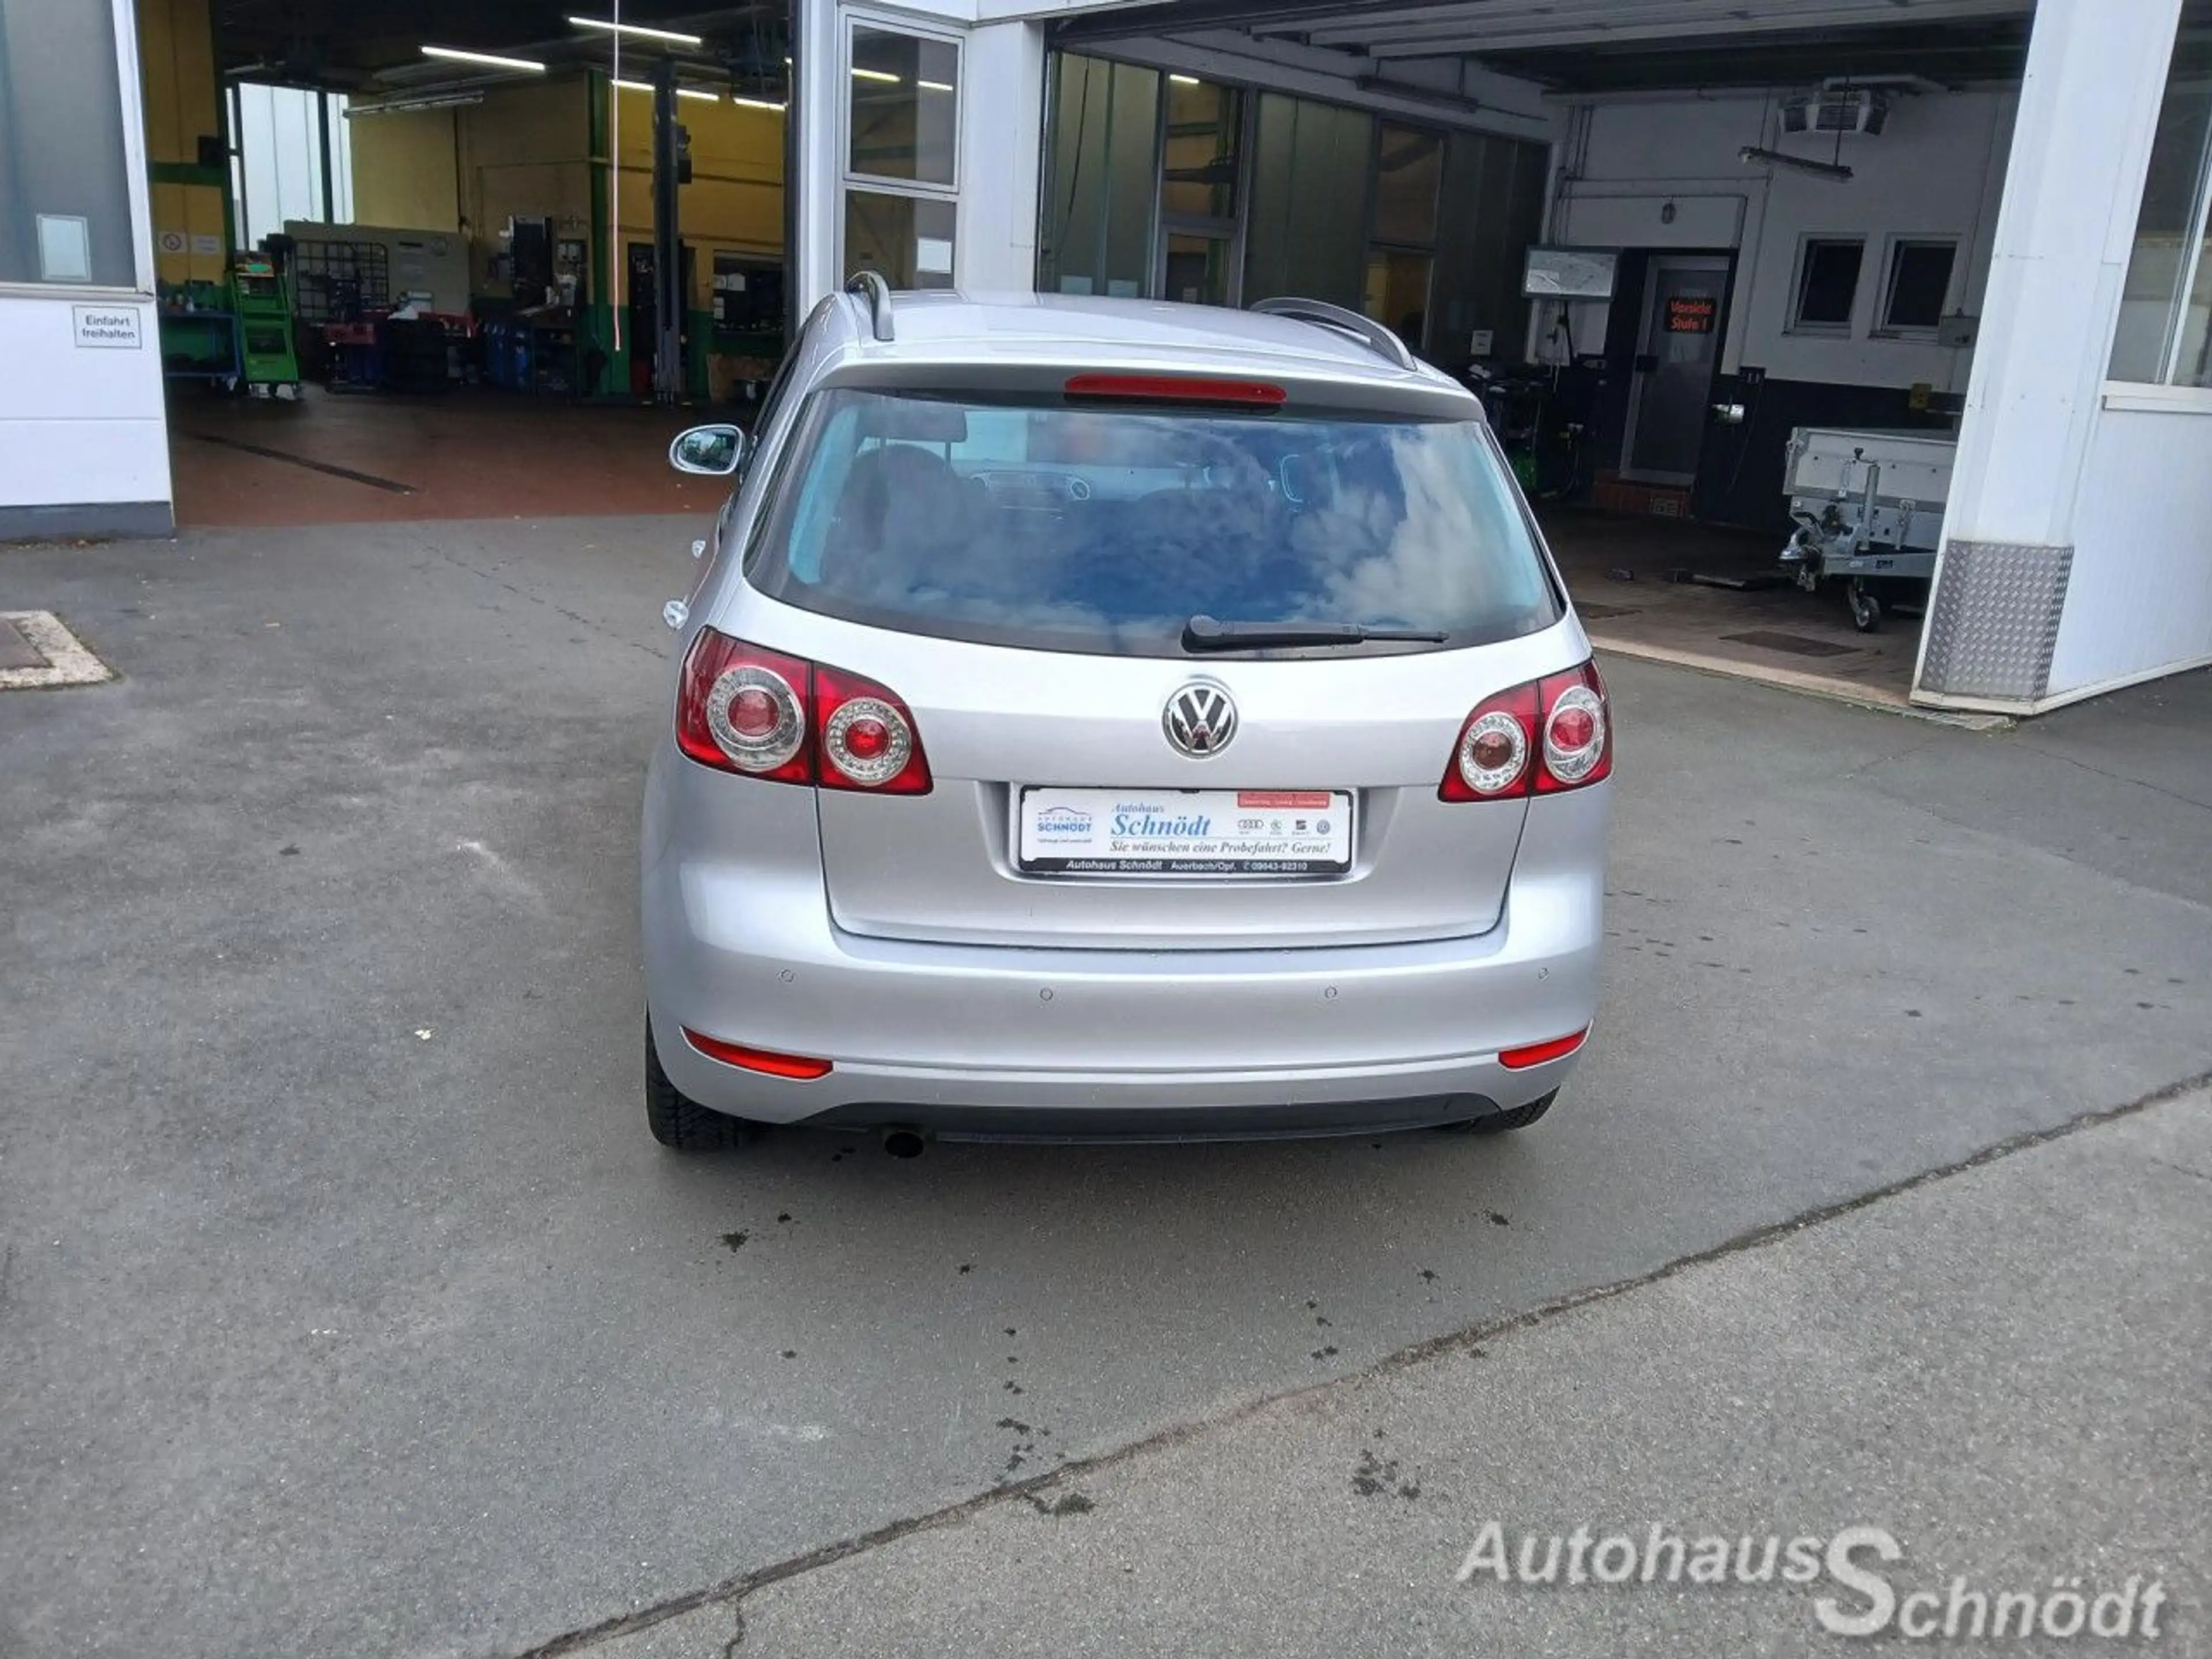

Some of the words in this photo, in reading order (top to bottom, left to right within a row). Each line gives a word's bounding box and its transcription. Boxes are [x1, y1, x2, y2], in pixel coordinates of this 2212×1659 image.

[85, 315, 130, 327] Einfahrt
[82, 328, 135, 339] freihalten
[1112, 802, 1164, 813] Autohaus
[1111, 814, 1211, 835] Schnödt
[1110, 841, 1129, 853] Sie
[1132, 842, 1190, 853] wünschen
[1192, 842, 1218, 853] eine
[1219, 842, 1288, 855] Probefahrt?
[1291, 842, 1331, 854] Gerne!
[1066, 860, 1118, 870] Autohaus
[1119, 860, 1162, 870] Schnödt
